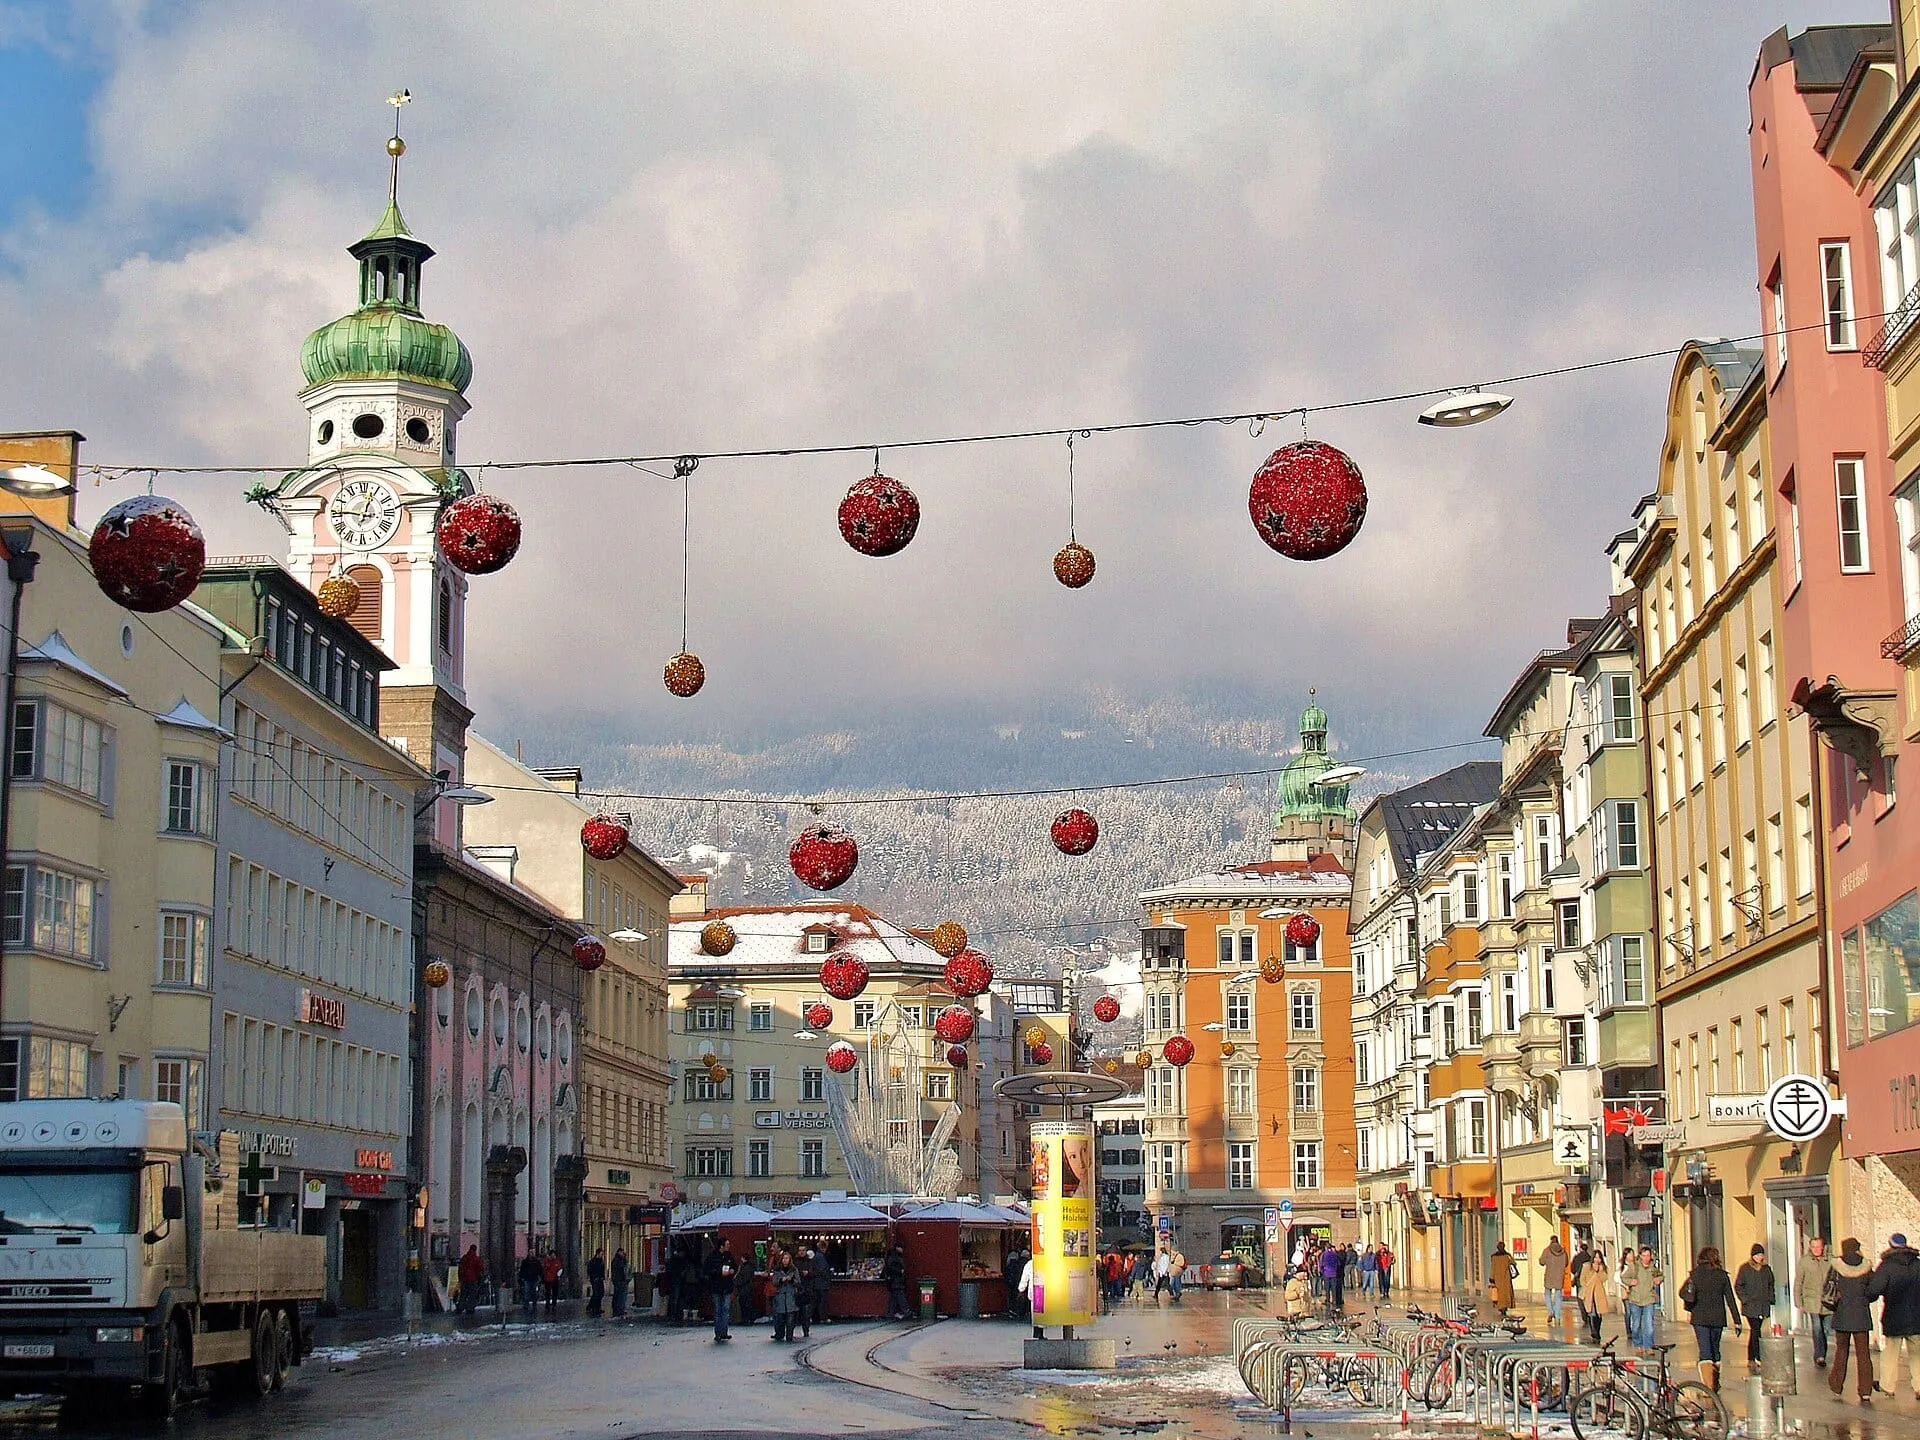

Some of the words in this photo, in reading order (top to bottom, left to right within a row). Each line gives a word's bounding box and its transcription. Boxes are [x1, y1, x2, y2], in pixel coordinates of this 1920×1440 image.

[1715, 1099, 1766, 1118] BONIT
[260, 1133, 298, 1156] APOTHEKE
[11, 1287, 51, 1296] IVECO
